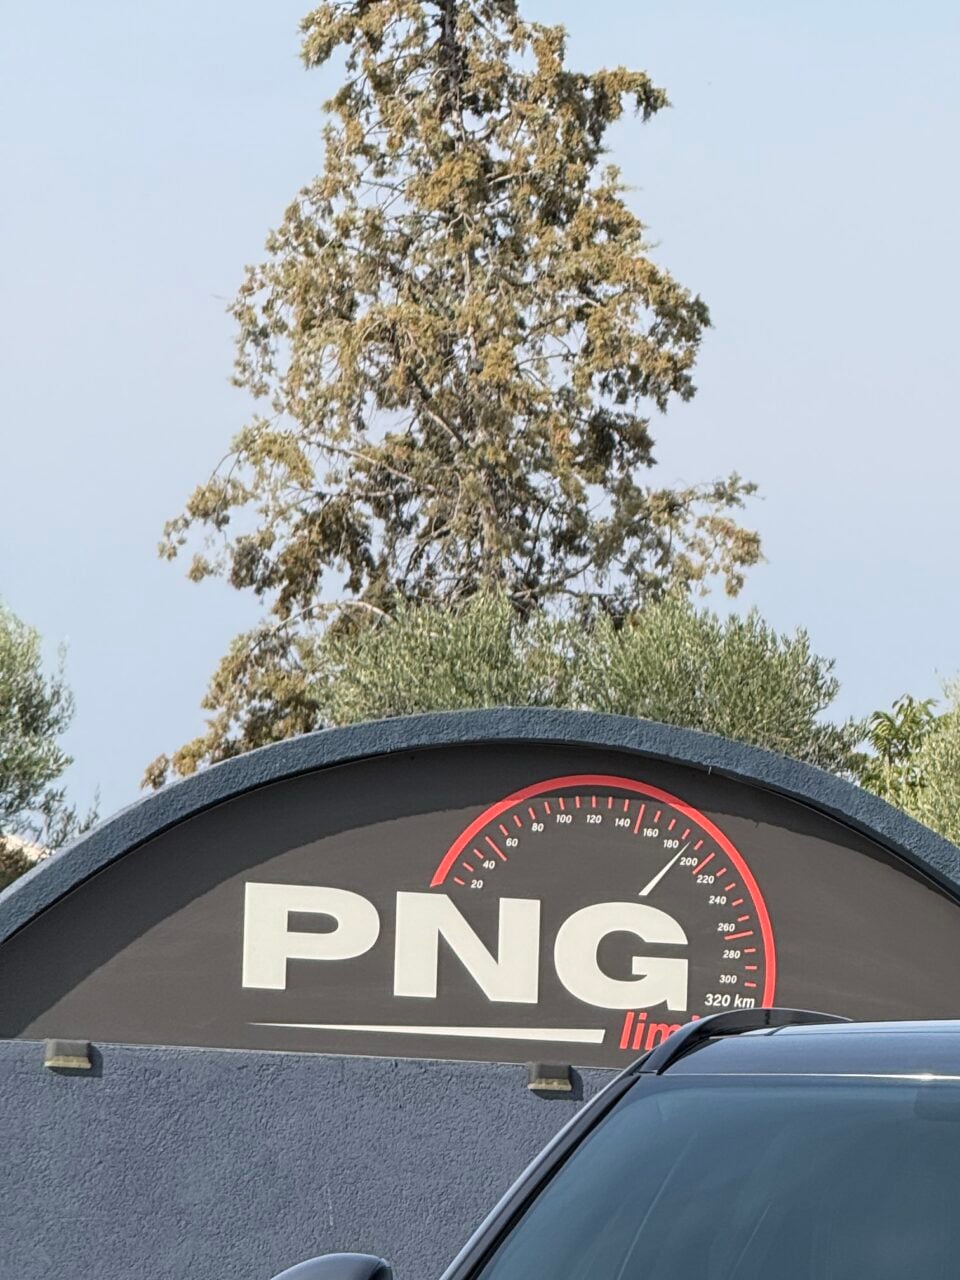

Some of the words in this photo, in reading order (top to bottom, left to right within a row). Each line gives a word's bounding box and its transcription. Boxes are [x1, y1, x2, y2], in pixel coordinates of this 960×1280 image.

[555, 813, 573, 824] 100
[586, 813, 602, 824] 120
[614, 817, 631, 828] 140
[531, 821, 545, 833] 80
[643, 827, 660, 838] 160
[505, 837, 519, 848] 60
[663, 838, 680, 849] 180
[482, 859, 496, 870] 40
[679, 856, 699, 867] 200
[470, 878, 484, 890] 20
[696, 874, 716, 886] 220
[708, 894, 728, 906] 240
[716, 921, 736, 933] 260
[242, 882, 689, 1012] PNG
[722, 948, 742, 960] 280
[718, 974, 738, 985] 300
[704, 993, 731, 1008] 320
[733, 994, 756, 1009] km
